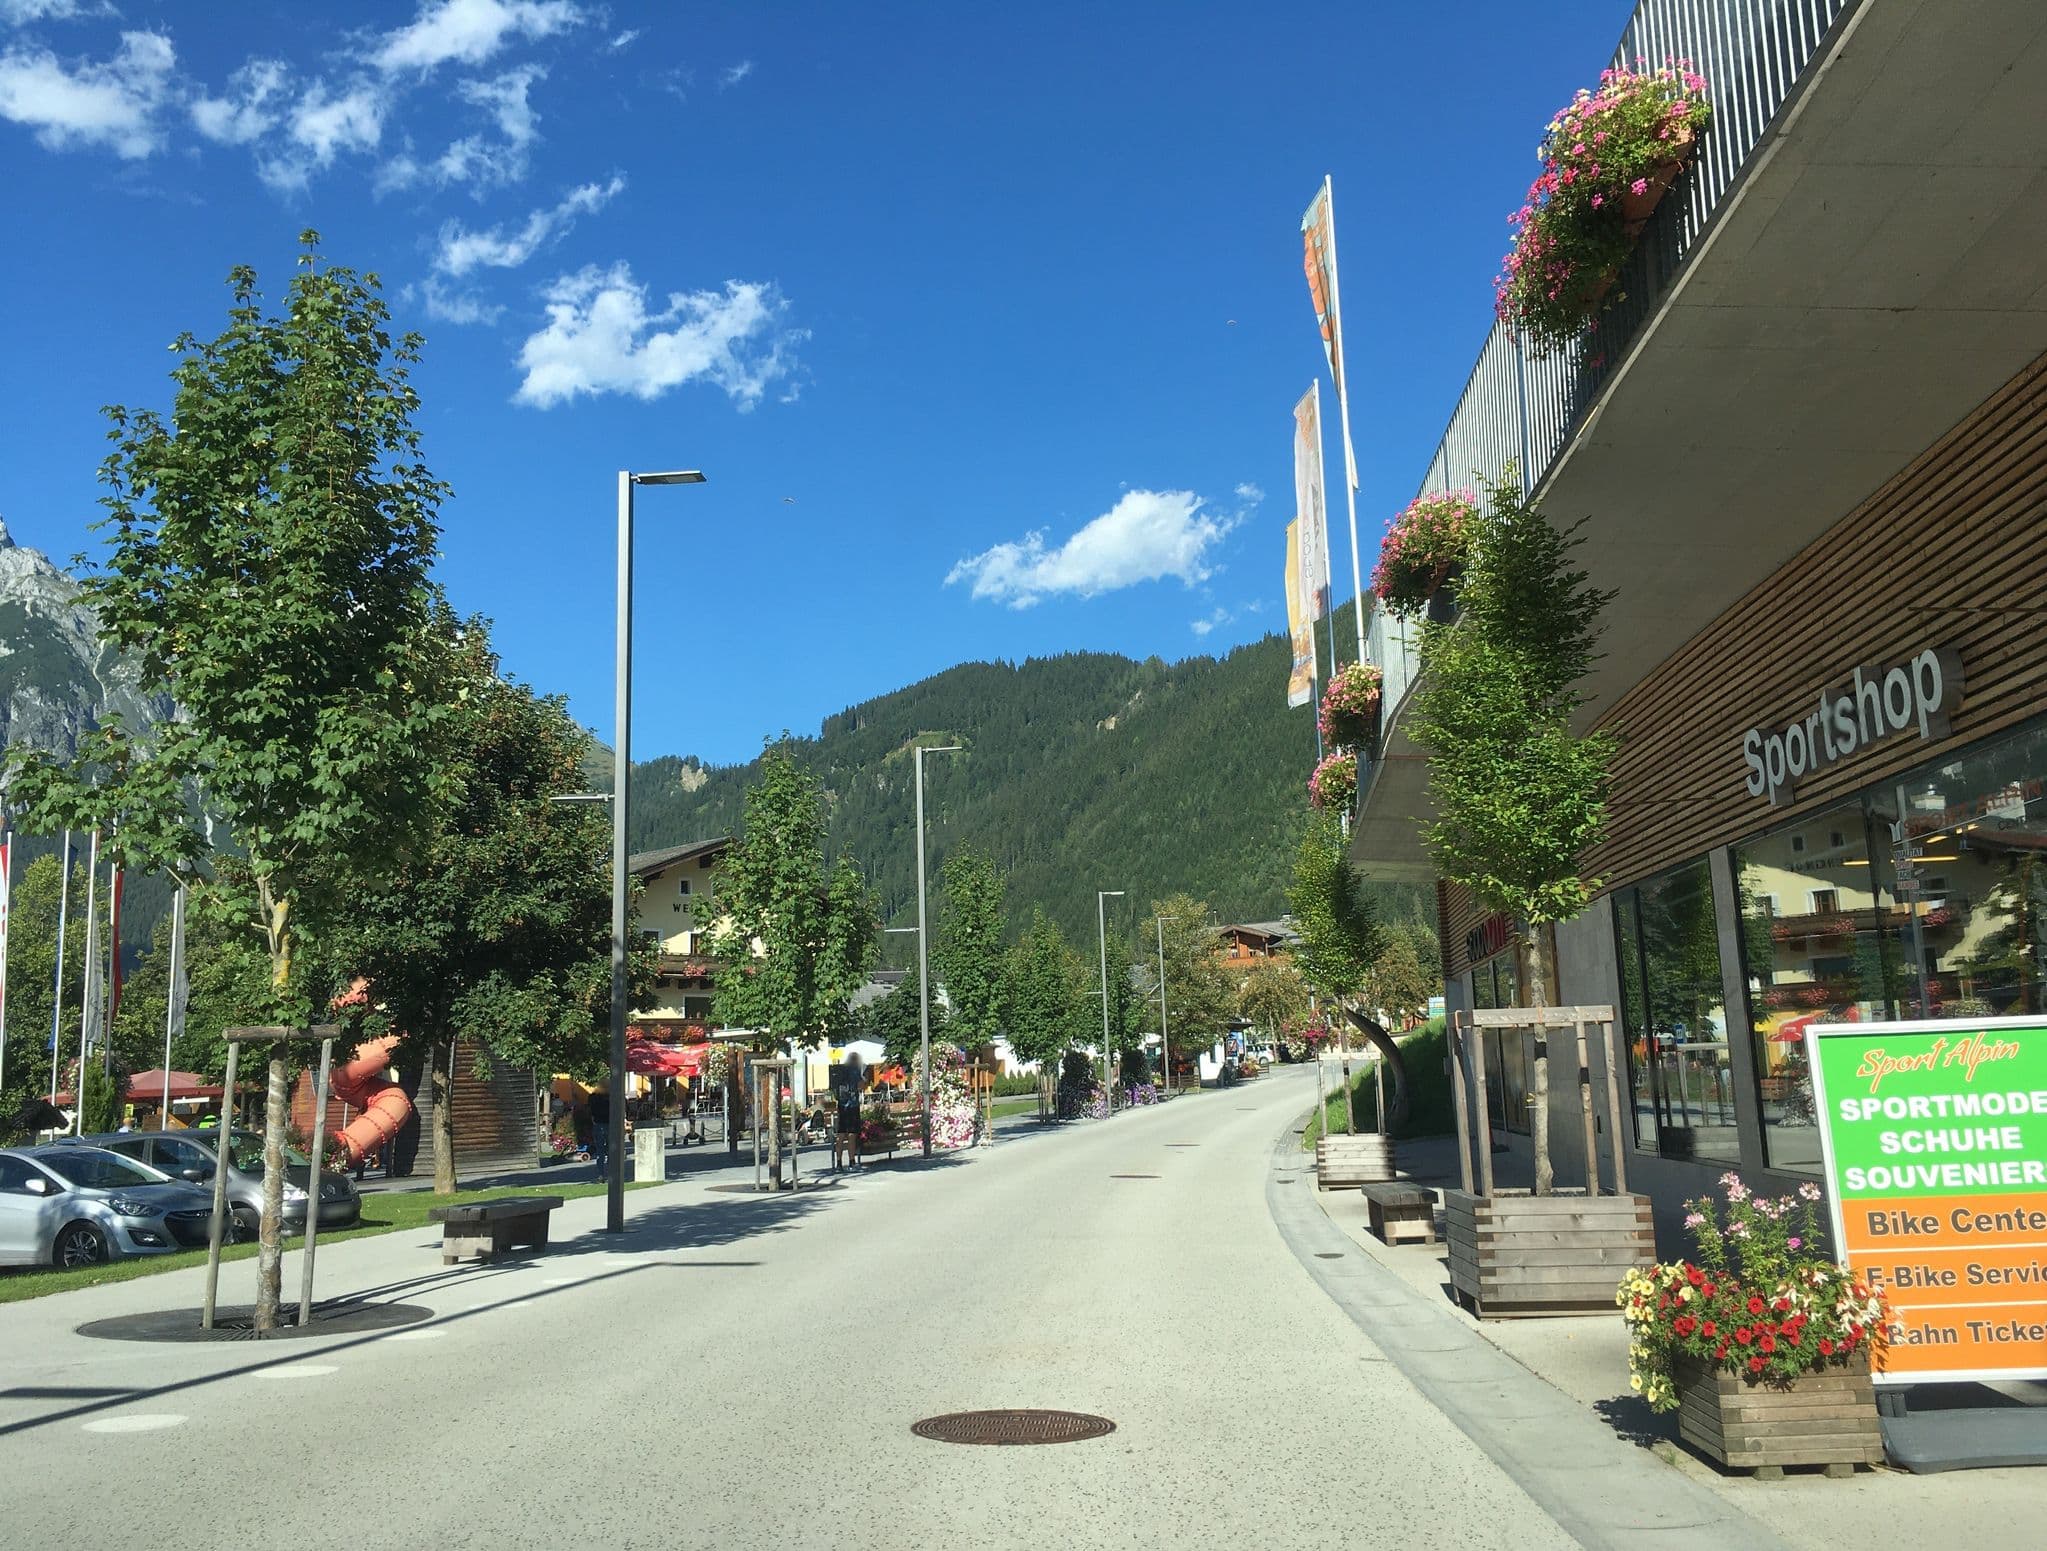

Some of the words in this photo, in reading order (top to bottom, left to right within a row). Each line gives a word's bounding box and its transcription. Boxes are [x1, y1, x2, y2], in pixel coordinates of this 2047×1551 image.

[1744, 649, 1942, 805] Sportshop
[1856, 1037, 1948, 1094] Sport
[1943, 1031, 2019, 1081] Alpin
[1840, 1091, 2047, 1121] SPORTMODE
[1879, 1127, 2023, 1154] SCHUHE
[1845, 1160, 2047, 1190] SOUVENIER
[1867, 1209, 1939, 1236] Bike
[1866, 1266, 1957, 1288] E-Bike
[1887, 1323, 1958, 1345] Bahn
[1966, 1321, 2047, 1342] Ticke
